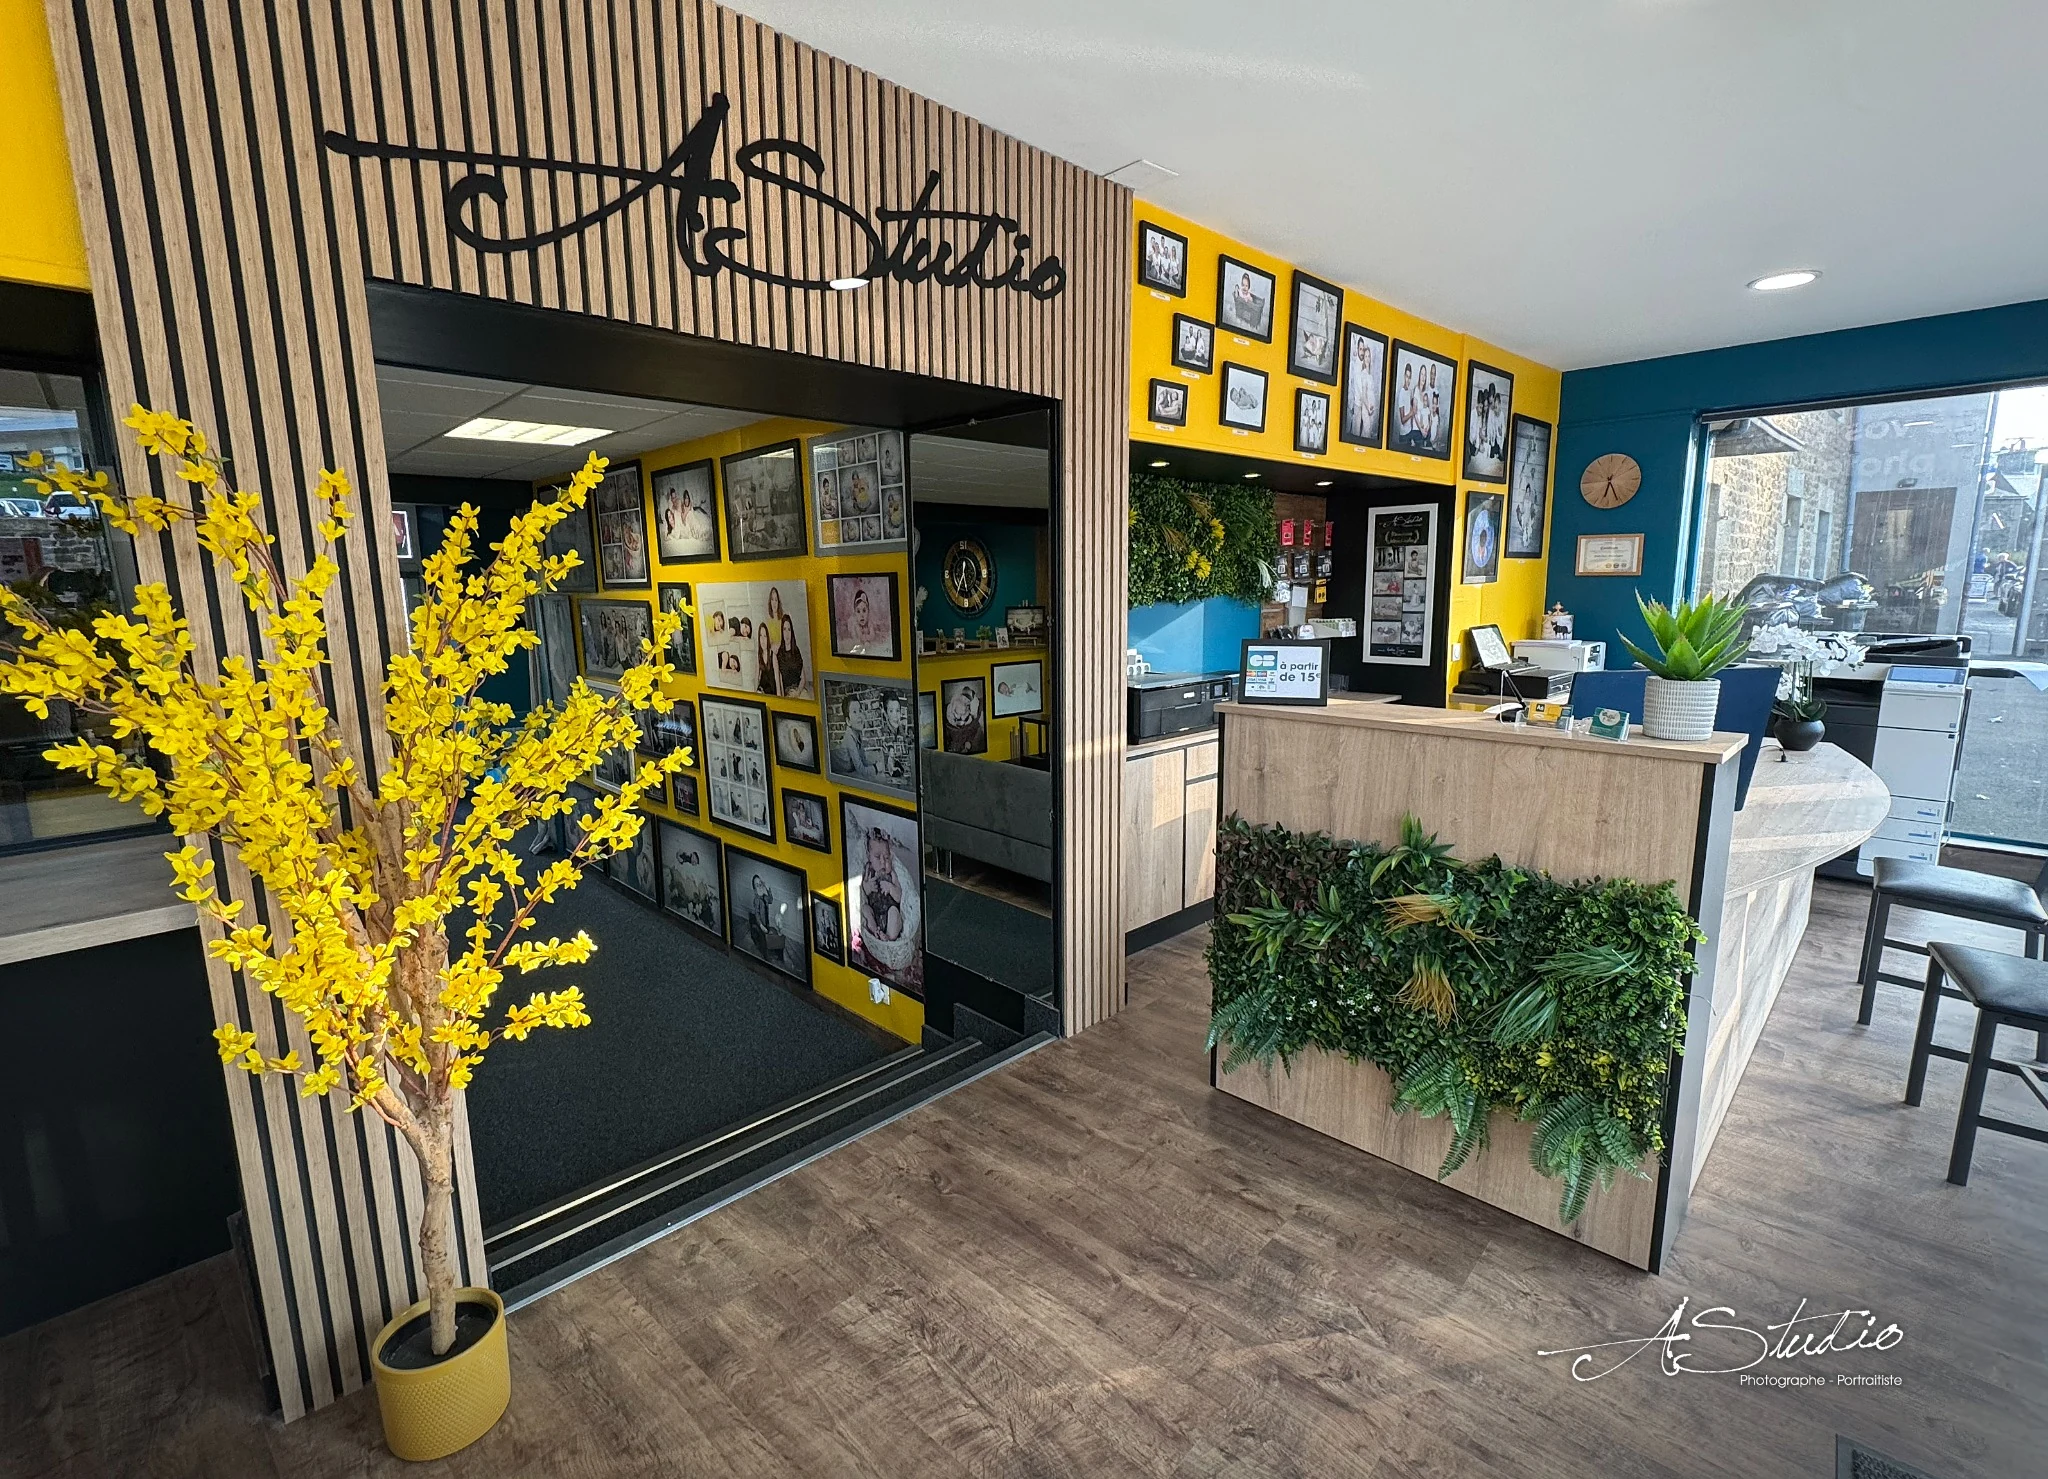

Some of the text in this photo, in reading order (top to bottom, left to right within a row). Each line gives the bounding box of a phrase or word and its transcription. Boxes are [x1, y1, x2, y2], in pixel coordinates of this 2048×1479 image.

[1280, 661, 1318, 671] à partir
[1279, 672, 1296, 682] de
